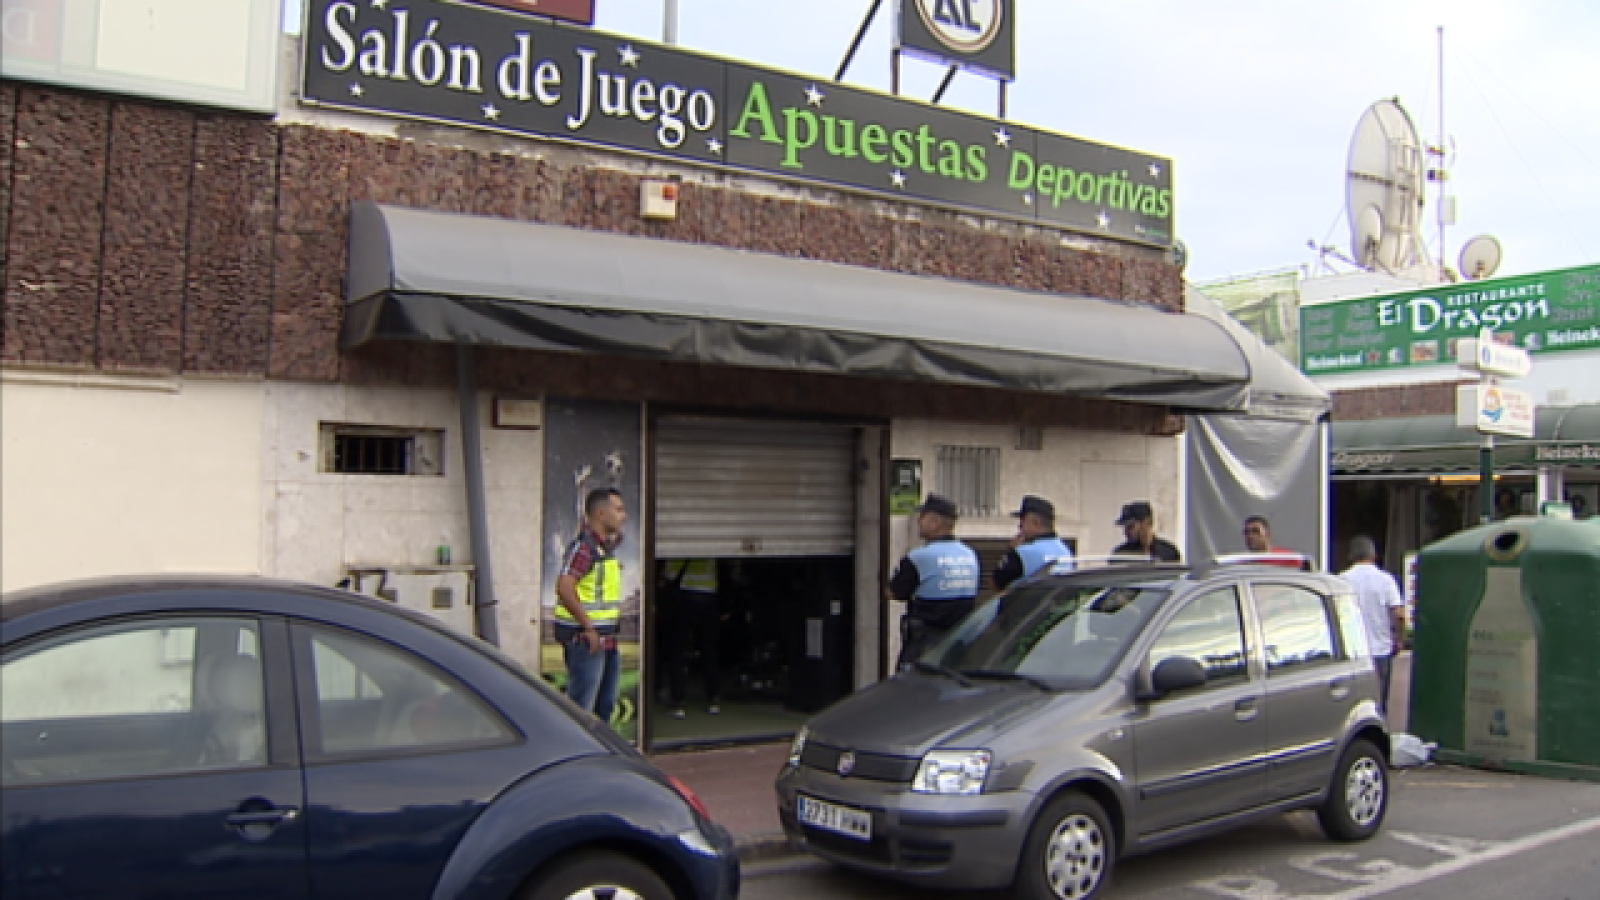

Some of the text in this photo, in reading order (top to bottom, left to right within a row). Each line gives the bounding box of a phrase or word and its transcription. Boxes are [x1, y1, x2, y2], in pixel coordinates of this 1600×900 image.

[321, 1, 1170, 218] Salón de Juego Apuestas Deportivas
